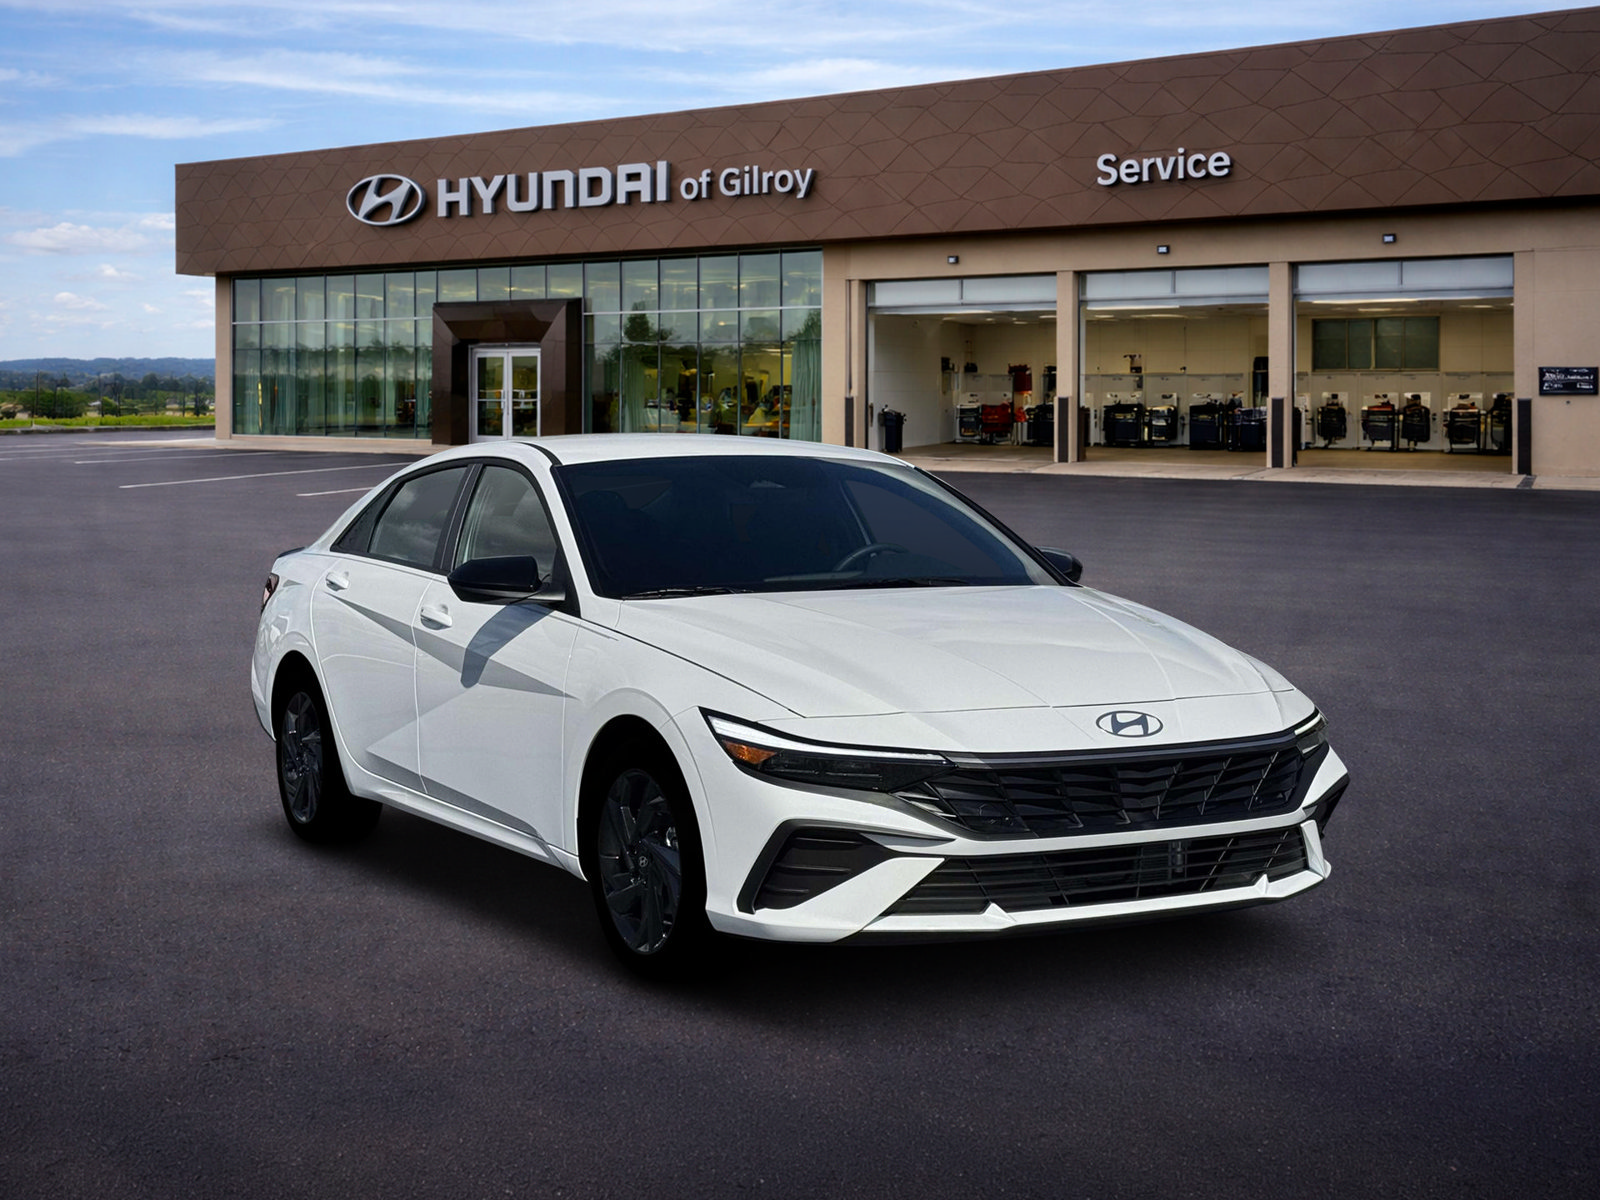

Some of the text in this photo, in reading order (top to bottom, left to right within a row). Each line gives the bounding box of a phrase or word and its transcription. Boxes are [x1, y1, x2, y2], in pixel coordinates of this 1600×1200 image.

[436, 160, 813, 218] HYUNDAI of Gilroy
[1096, 147, 1231, 186] Service
